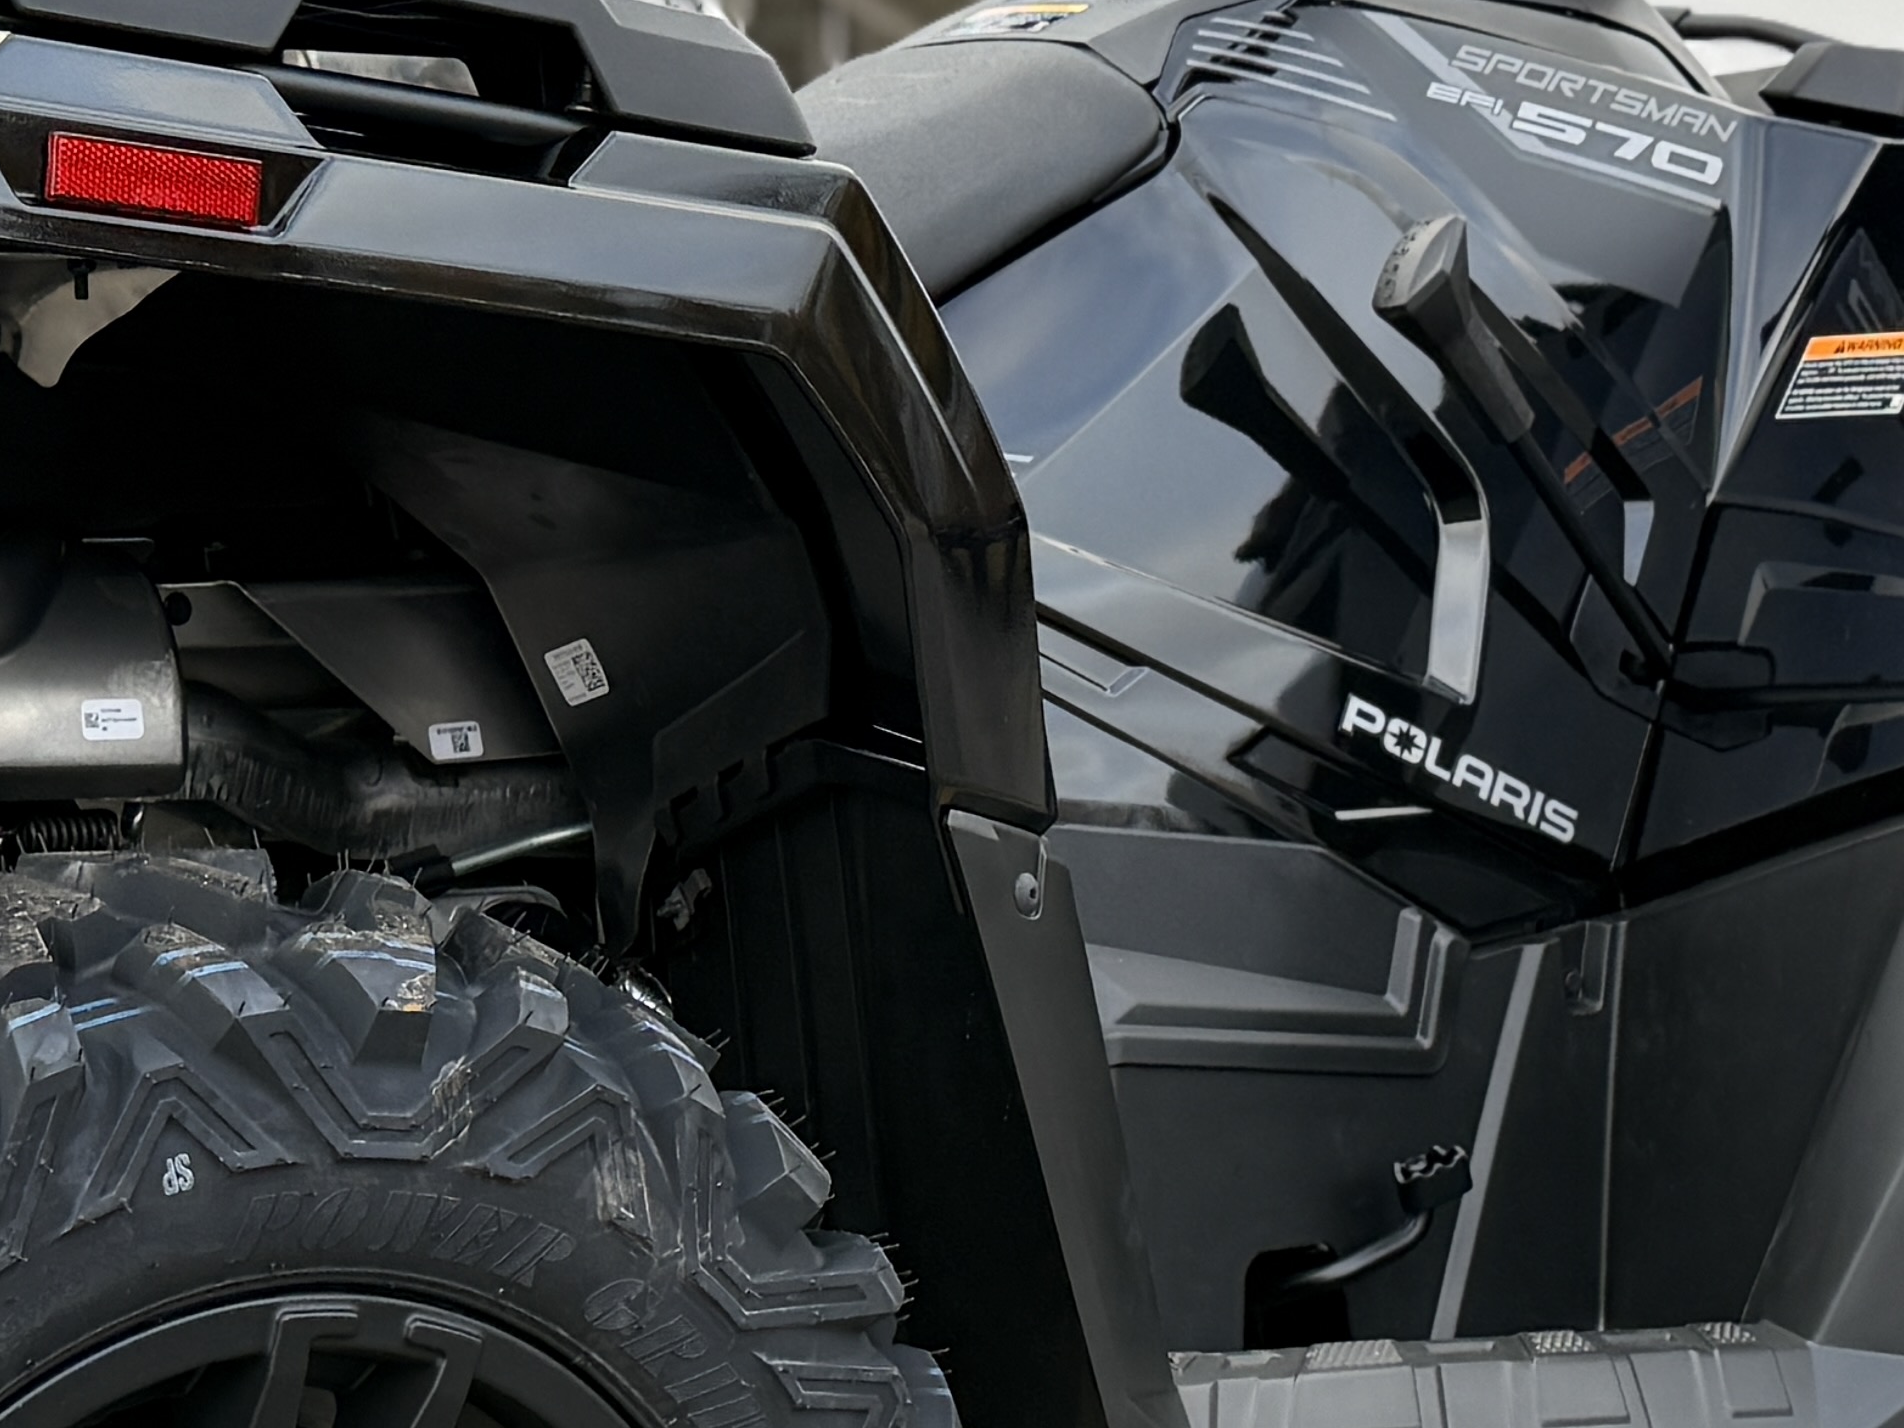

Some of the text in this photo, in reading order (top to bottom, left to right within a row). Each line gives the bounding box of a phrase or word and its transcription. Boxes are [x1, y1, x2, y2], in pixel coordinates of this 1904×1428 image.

[1426, 81, 1724, 186] EFI 570
[1450, 44, 1738, 143] SPORTSMAN
[1340, 693, 1579, 844] POLARIS
[226, 1186, 578, 1288] POWER
